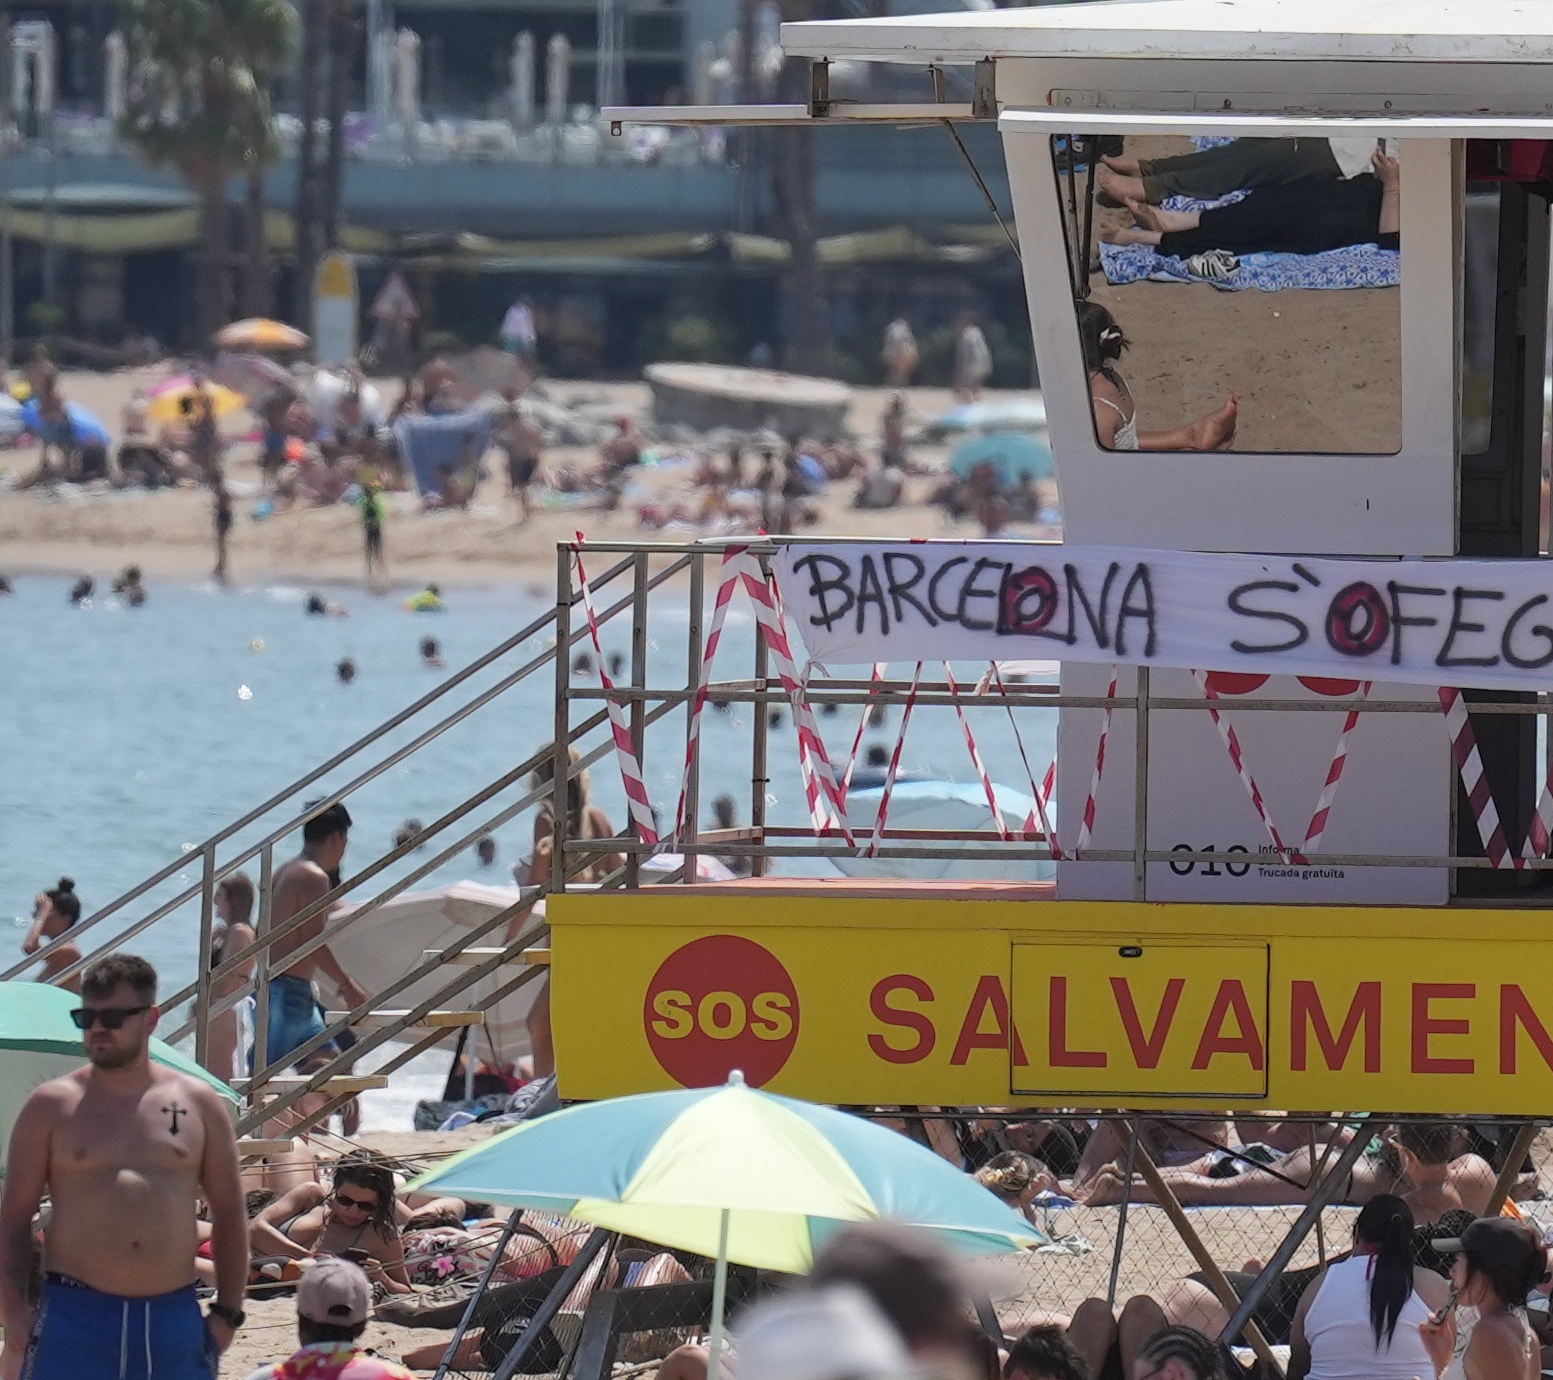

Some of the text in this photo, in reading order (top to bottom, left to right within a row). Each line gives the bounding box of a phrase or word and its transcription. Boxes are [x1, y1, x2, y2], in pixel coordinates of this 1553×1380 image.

[793, 551, 1158, 658] BARCELONA
[1169, 843, 1251, 877] 010
[1258, 868, 1300, 878] Trucada
[651, 990, 793, 1040] SOS
